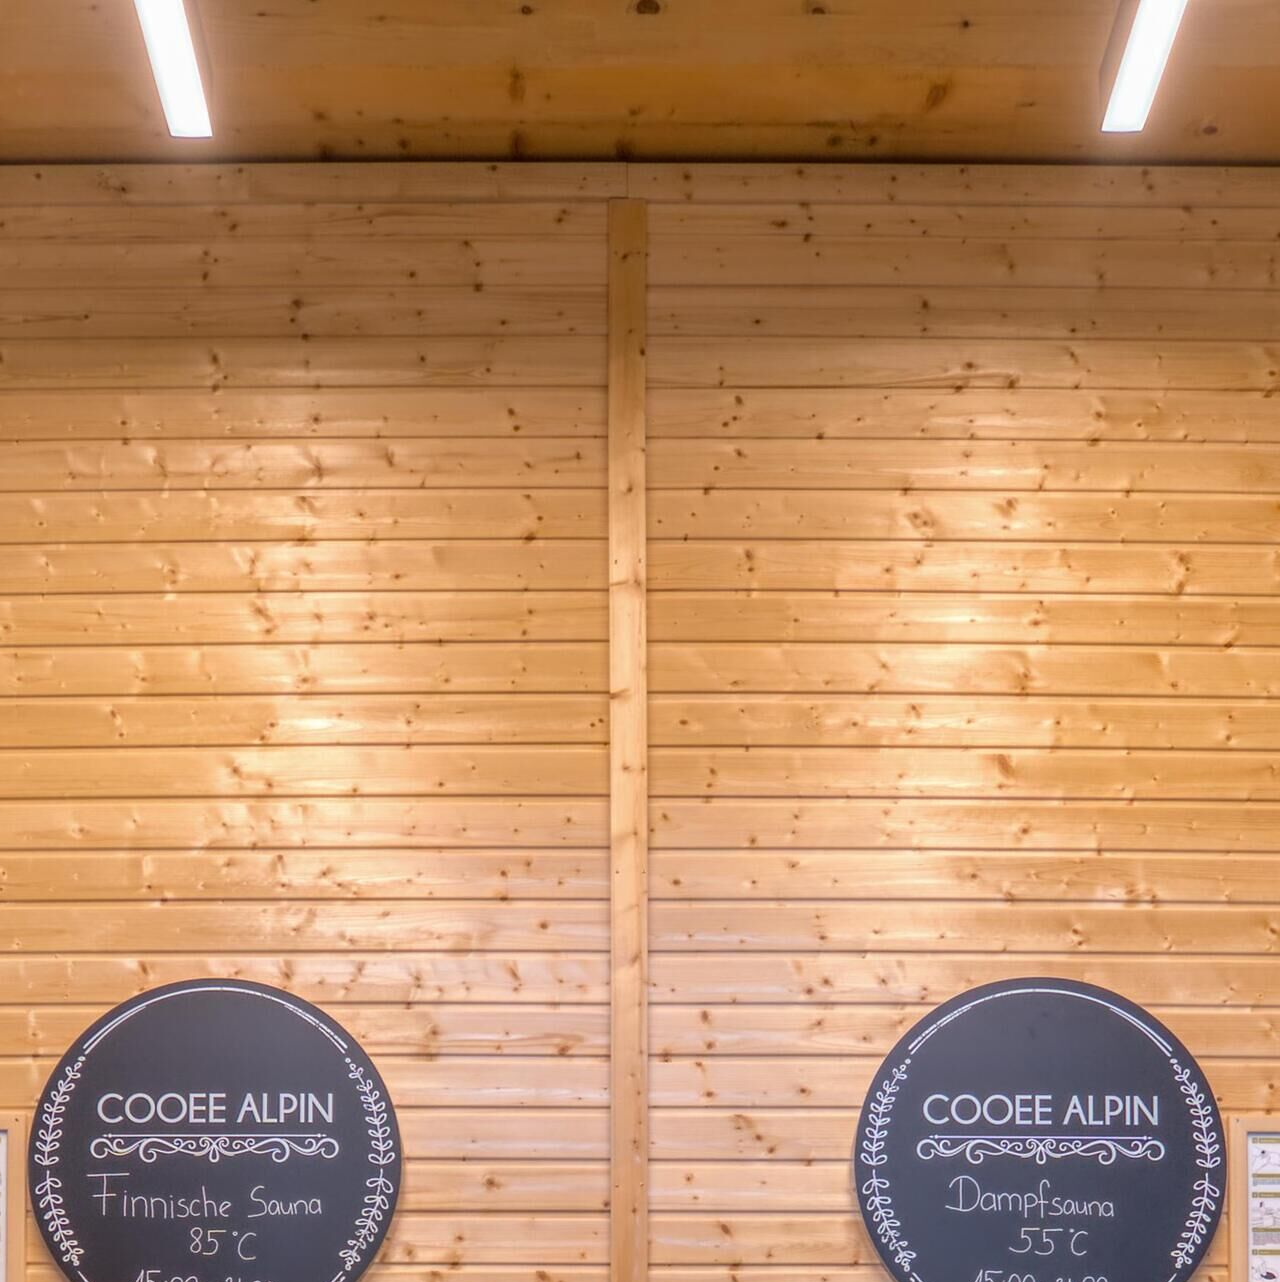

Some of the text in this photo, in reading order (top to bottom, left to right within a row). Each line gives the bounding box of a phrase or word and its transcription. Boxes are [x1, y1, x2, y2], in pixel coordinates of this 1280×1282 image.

[96, 1092, 334, 1125] COOEE ALPIN
[922, 1094, 1158, 1126] COOEE ALPIN
[86, 1172, 322, 1219] Finnische Sauna
[944, 1175, 1115, 1219] Dampfsauna
